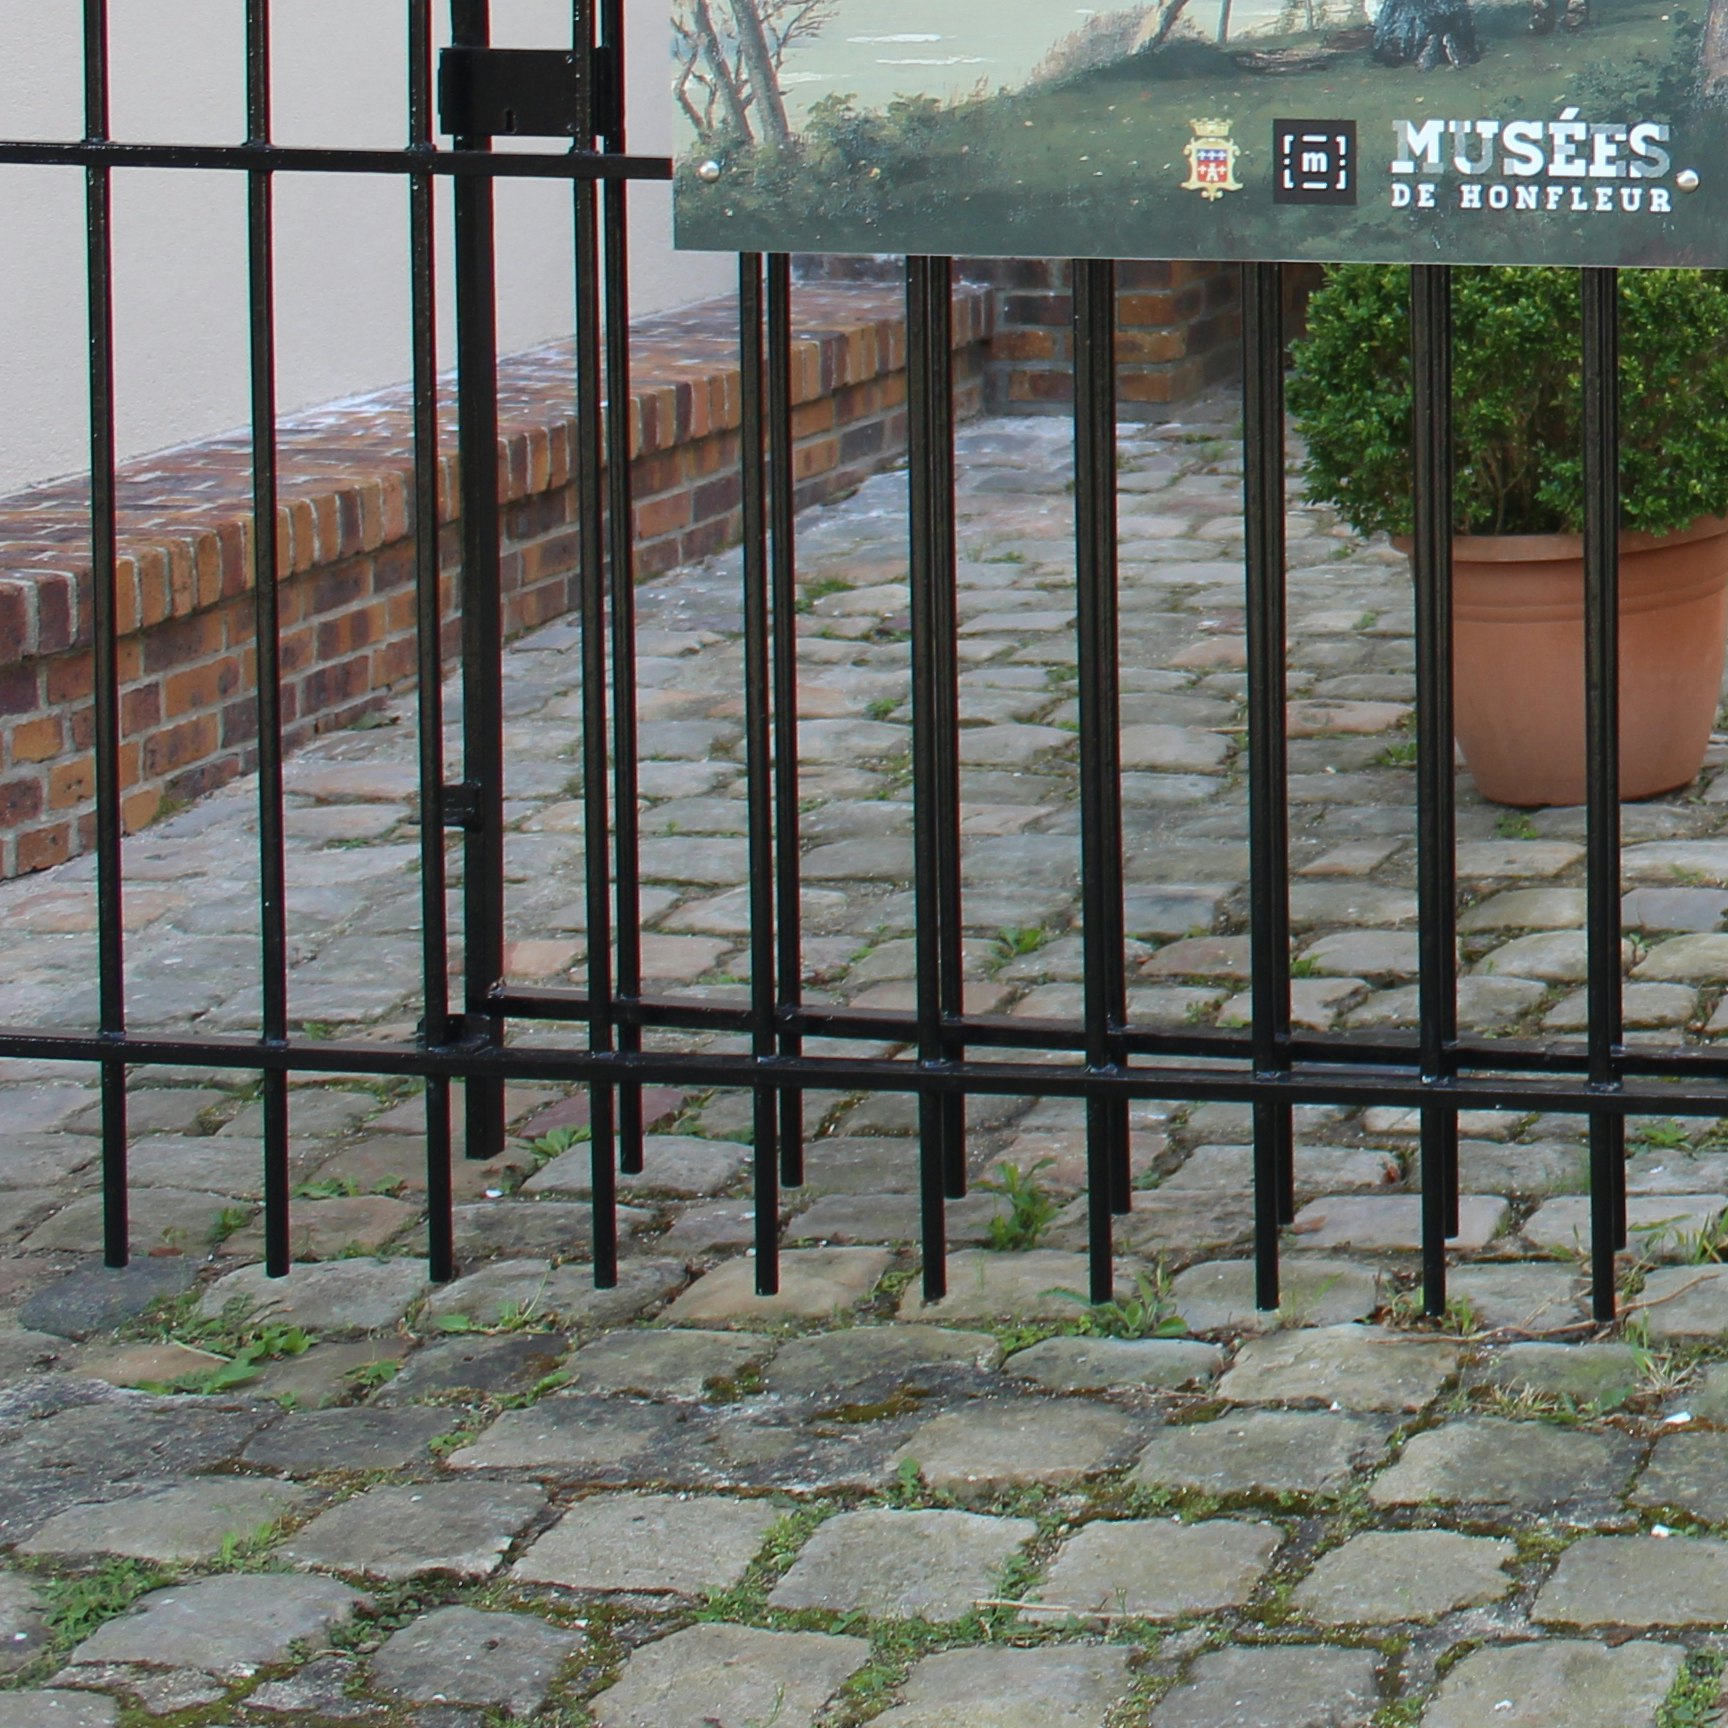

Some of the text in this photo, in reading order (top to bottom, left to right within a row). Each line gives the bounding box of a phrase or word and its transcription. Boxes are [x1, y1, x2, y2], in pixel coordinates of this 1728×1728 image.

[1391, 108, 1672, 179] MUSÉES
[1302, 151, 1328, 173] m
[1391, 183, 1672, 212] DE HONFLEUR
